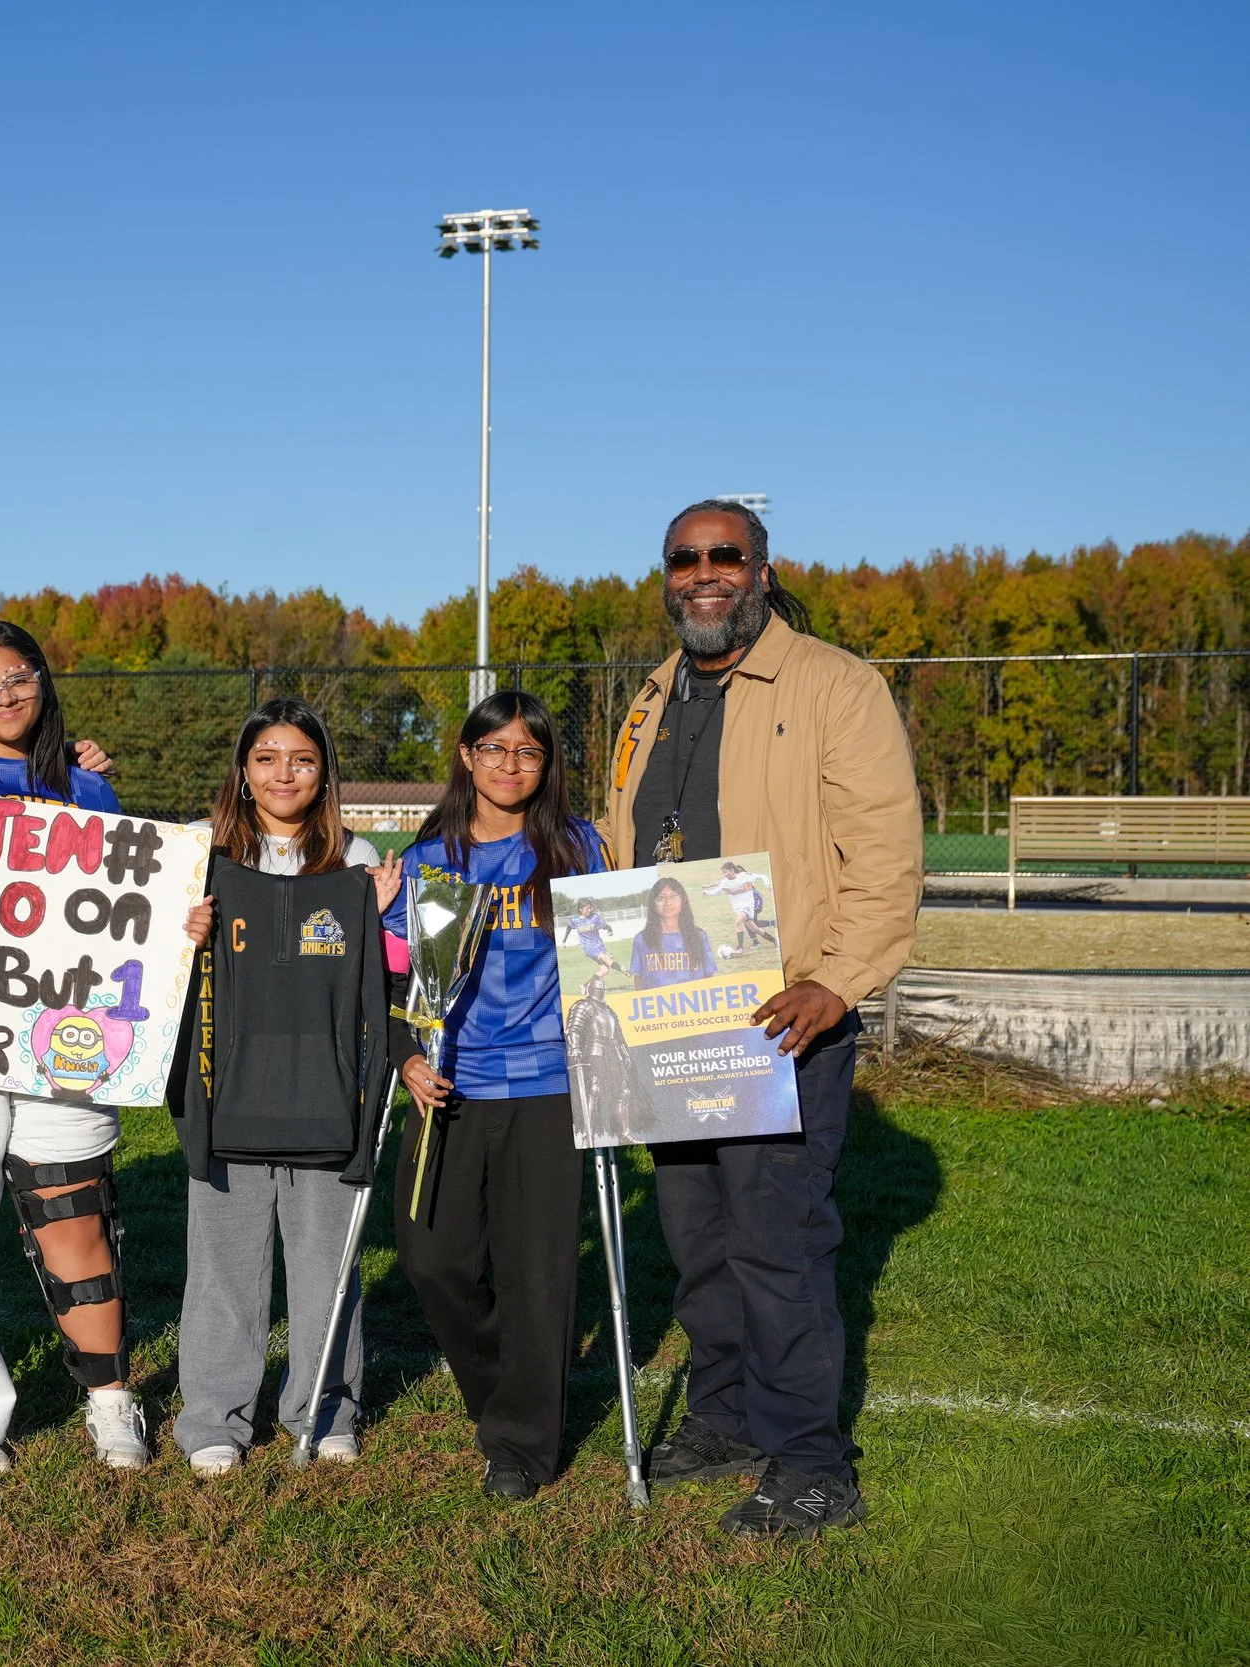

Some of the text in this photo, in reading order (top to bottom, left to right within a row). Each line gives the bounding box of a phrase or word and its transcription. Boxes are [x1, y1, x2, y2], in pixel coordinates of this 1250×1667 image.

[232, 918, 246, 952] C
[301, 941, 345, 955] KNIGHTS
[106, 959, 150, 1021] 1
[628, 984, 761, 1021] JENNIFER
[634, 1022, 668, 1033] VARSITY
[671, 1019, 695, 1029] GIRLS
[697, 1016, 730, 1026] SOCCER
[650, 1045, 745, 1065] YOUR KNIGHTS
[652, 1055, 771, 1078] WATCH HAS ENDED
[654, 1079, 666, 1087] BUT
[667, 1077, 684, 1085] ONCE
[717, 1071, 744, 1080] ALWAYS
